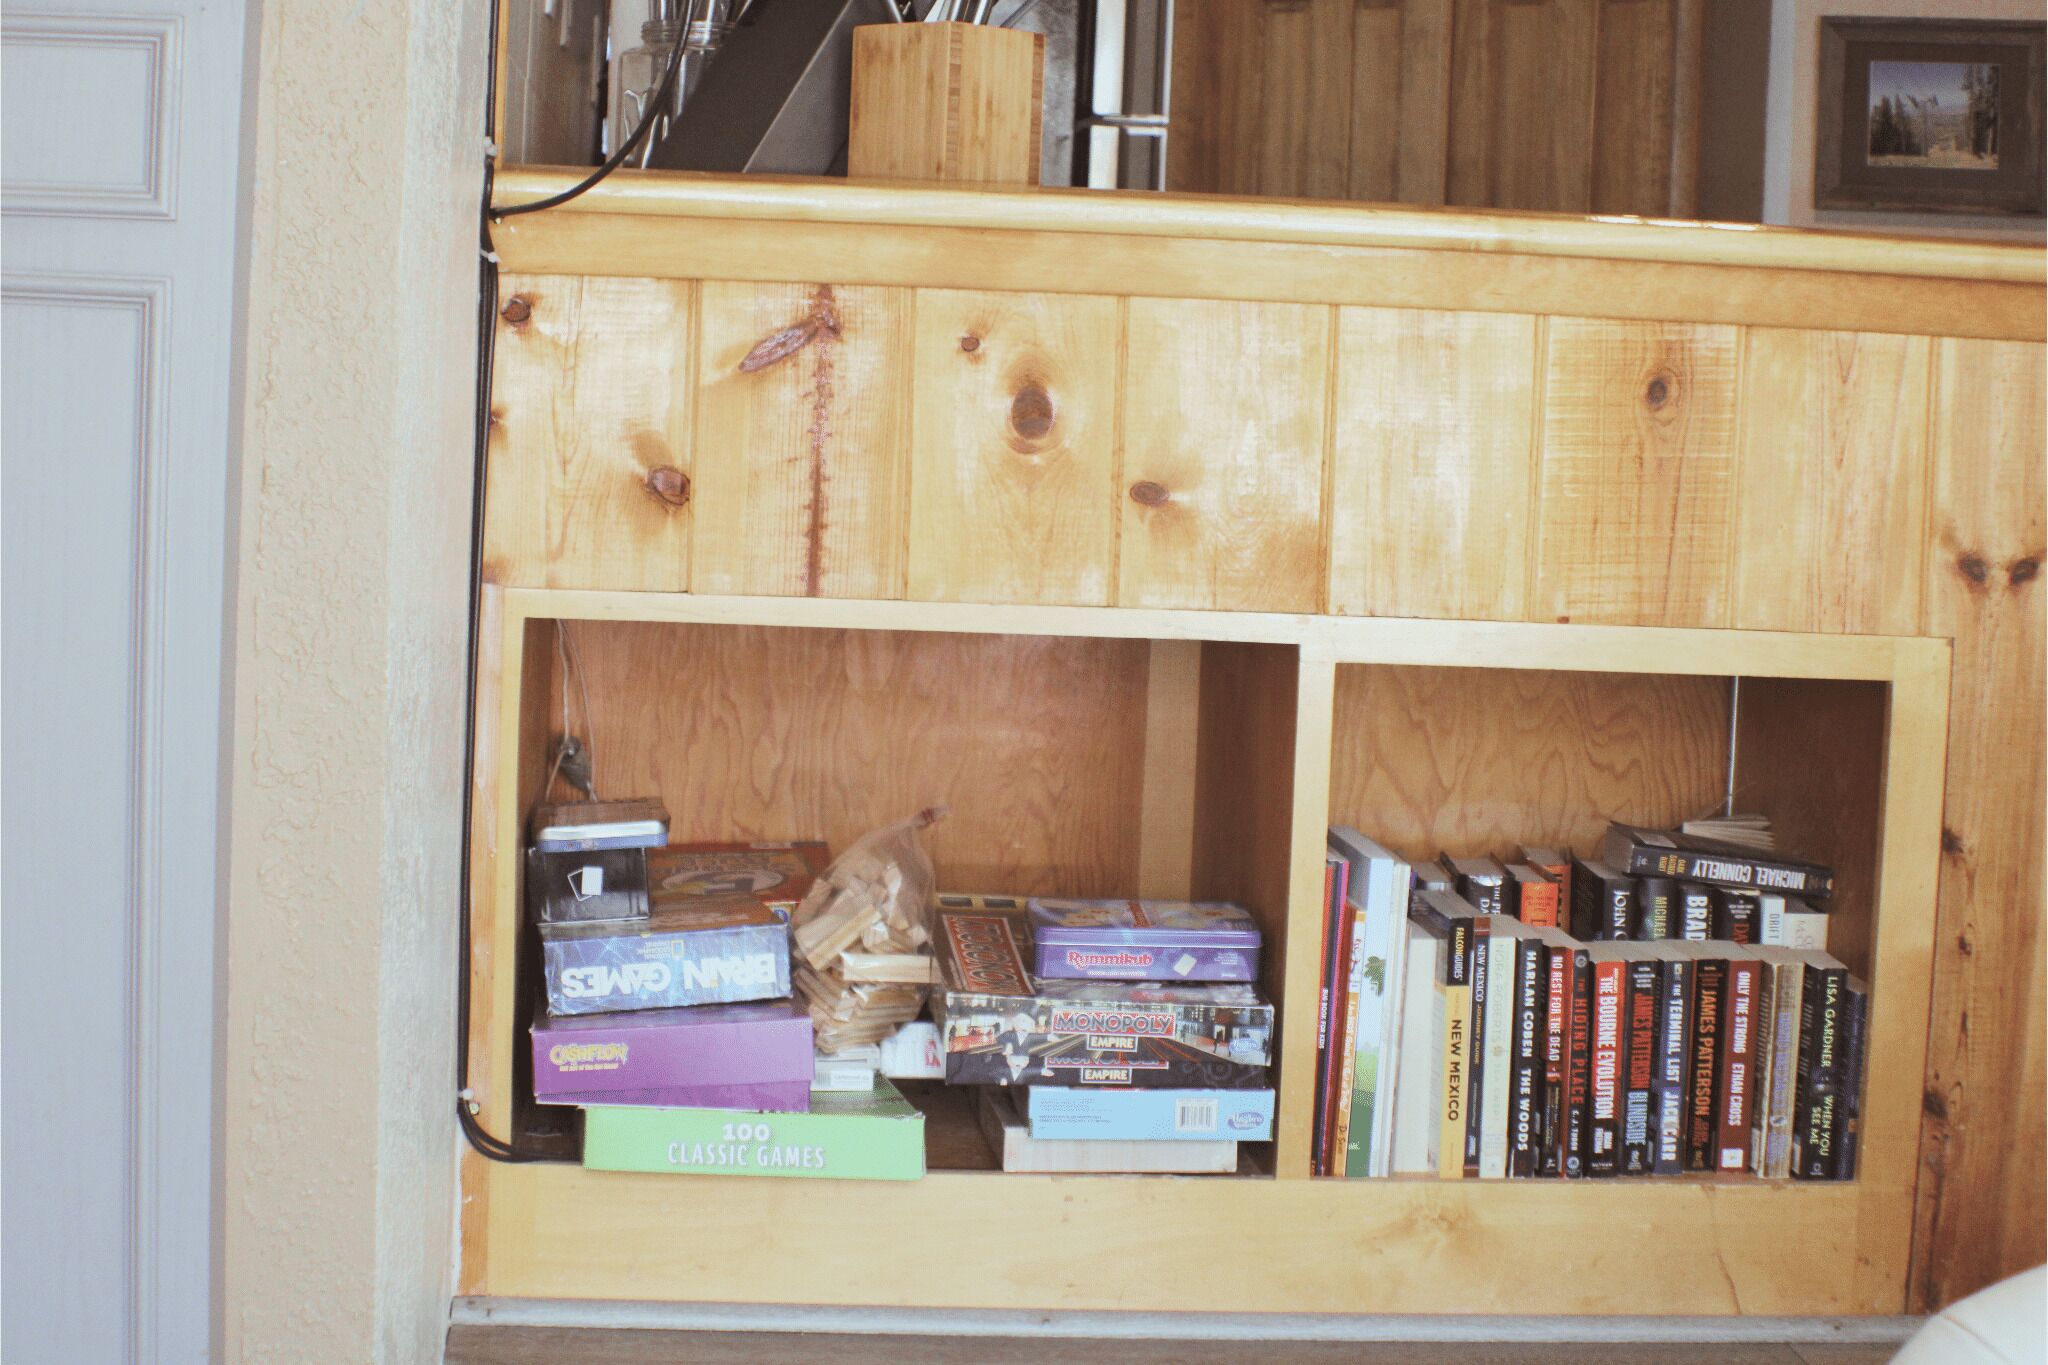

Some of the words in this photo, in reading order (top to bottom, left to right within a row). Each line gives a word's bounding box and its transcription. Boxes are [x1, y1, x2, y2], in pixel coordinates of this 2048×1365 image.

[1691, 858, 1753, 884] CONNELLY
[1755, 866, 1806, 890] MICHAEL
[1613, 889, 1630, 927] JOHN
[1653, 896, 1667, 938] MICHAEL
[1768, 913, 1781, 939] DRIFT
[1067, 951, 1153, 970] Rummikub
[1453, 927, 1465, 980] FALCONGUIDES
[1477, 945, 1486, 965] NEW
[1552, 956, 1563, 969] NO
[561, 962, 671, 999] GAMES
[1475, 966, 1485, 1002] MEXICO
[1523, 951, 1537, 1007] HARLAN
[1551, 970, 1563, 994] REST
[1599, 976, 1614, 994] THE
[1673, 984, 1681, 997] THE
[1737, 971, 1752, 994] ONLY
[1825, 976, 1838, 1005] LISA
[1491, 985, 1504, 1043] ROBERTS
[1550, 996, 1562, 1015] FOR
[1632, 992, 1653, 1029] JAMES
[1699, 989, 1718, 1034] JAMES
[1736, 997, 1749, 1015] THE
[1057, 1013, 1171, 1034] MONOPOLY
[1521, 1011, 1535, 1058] COBEN
[1550, 1016, 1561, 1034] THE
[1573, 998, 1587, 1052] HIDING
[1597, 995, 1617, 1048] BOURNE
[1667, 998, 1684, 1055] TERMINAL
[1733, 1016, 1747, 1054] STRONG
[1090, 1036, 1135, 1050] EMPIRE
[1451, 1019, 1462, 1056] NEW
[1549, 1035, 1561, 1061] DEAD
[1821, 1009, 1836, 1068] GARDNER
[1084, 1069, 1128, 1081] EMPIRE
[1630, 1030, 1652, 1089] PATTERSON
[1666, 1058, 1680, 1083] LIST
[1448, 1061, 1462, 1121] MEXICO
[1519, 1068, 1532, 1094] THE
[1570, 1058, 1584, 1105] PLACE
[1595, 1050, 1615, 1119] EVOLUTION
[1695, 1036, 1714, 1116] PATTERSON
[1730, 1062, 1745, 1094] ETHAN
[1625, 1090, 1648, 1146] BLINDSIDE
[1662, 1091, 1678, 1122] JACK
[1728, 1095, 1742, 1126] CROSS
[1810, 1106, 1821, 1125] SEE
[1821, 1095, 1833, 1129] WHEN
[722, 1123, 770, 1142] 100
[1517, 1098, 1531, 1152] WOODS
[1809, 1128, 1820, 1145] ME
[667, 1142, 749, 1166] CLASSIC
[756, 1145, 826, 1169] GAMES
[1661, 1126, 1677, 1161] CARR
[1819, 1131, 1830, 1156] YOU
